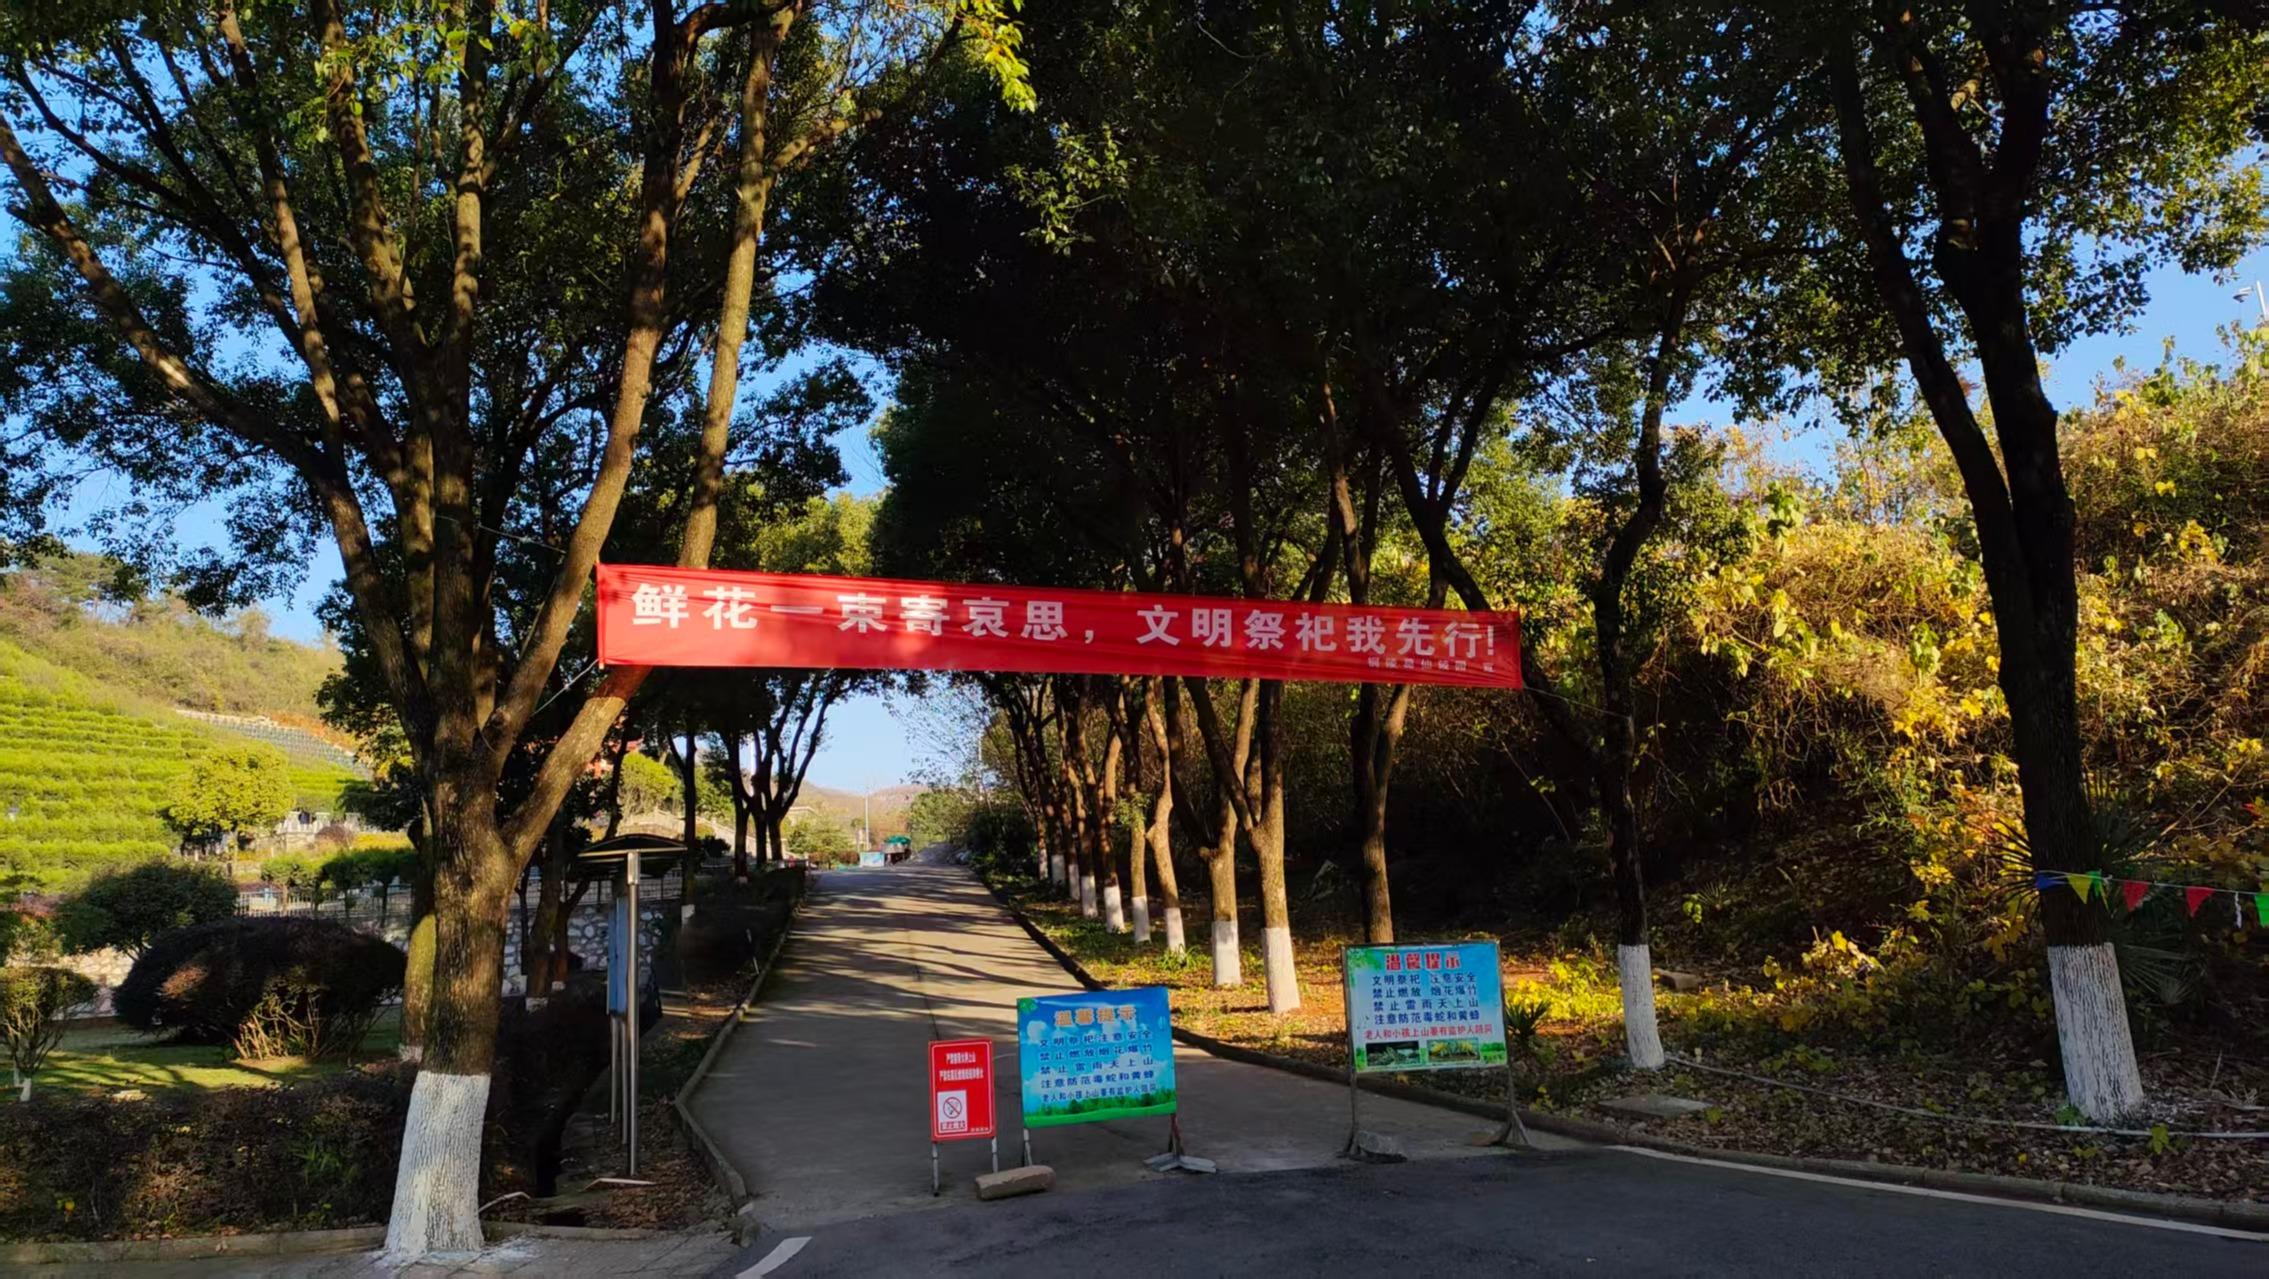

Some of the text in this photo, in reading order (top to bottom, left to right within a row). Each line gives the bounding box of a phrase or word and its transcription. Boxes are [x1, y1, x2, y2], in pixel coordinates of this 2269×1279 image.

[1385, 952, 1461, 971] 温馨提示
[1372, 972, 1478, 986] 文明祭祀 注意安全
[1373, 984, 1477, 998] 禁止燃放 烟花爆竹
[1373, 998, 1479, 1012] 禁止雷雨天上山
[1054, 1005, 1136, 1027] 温馨提示
[1374, 1010, 1480, 1025] 注意防范毒蛇和黄蜂
[1040, 1043, 1153, 1061] 禁止燃放烟花爆竹
[1040, 1057, 1154, 1075] 禁止雷雨天上山
[1041, 1070, 1155, 1089] 注意防范毒蛇和黄蜂
